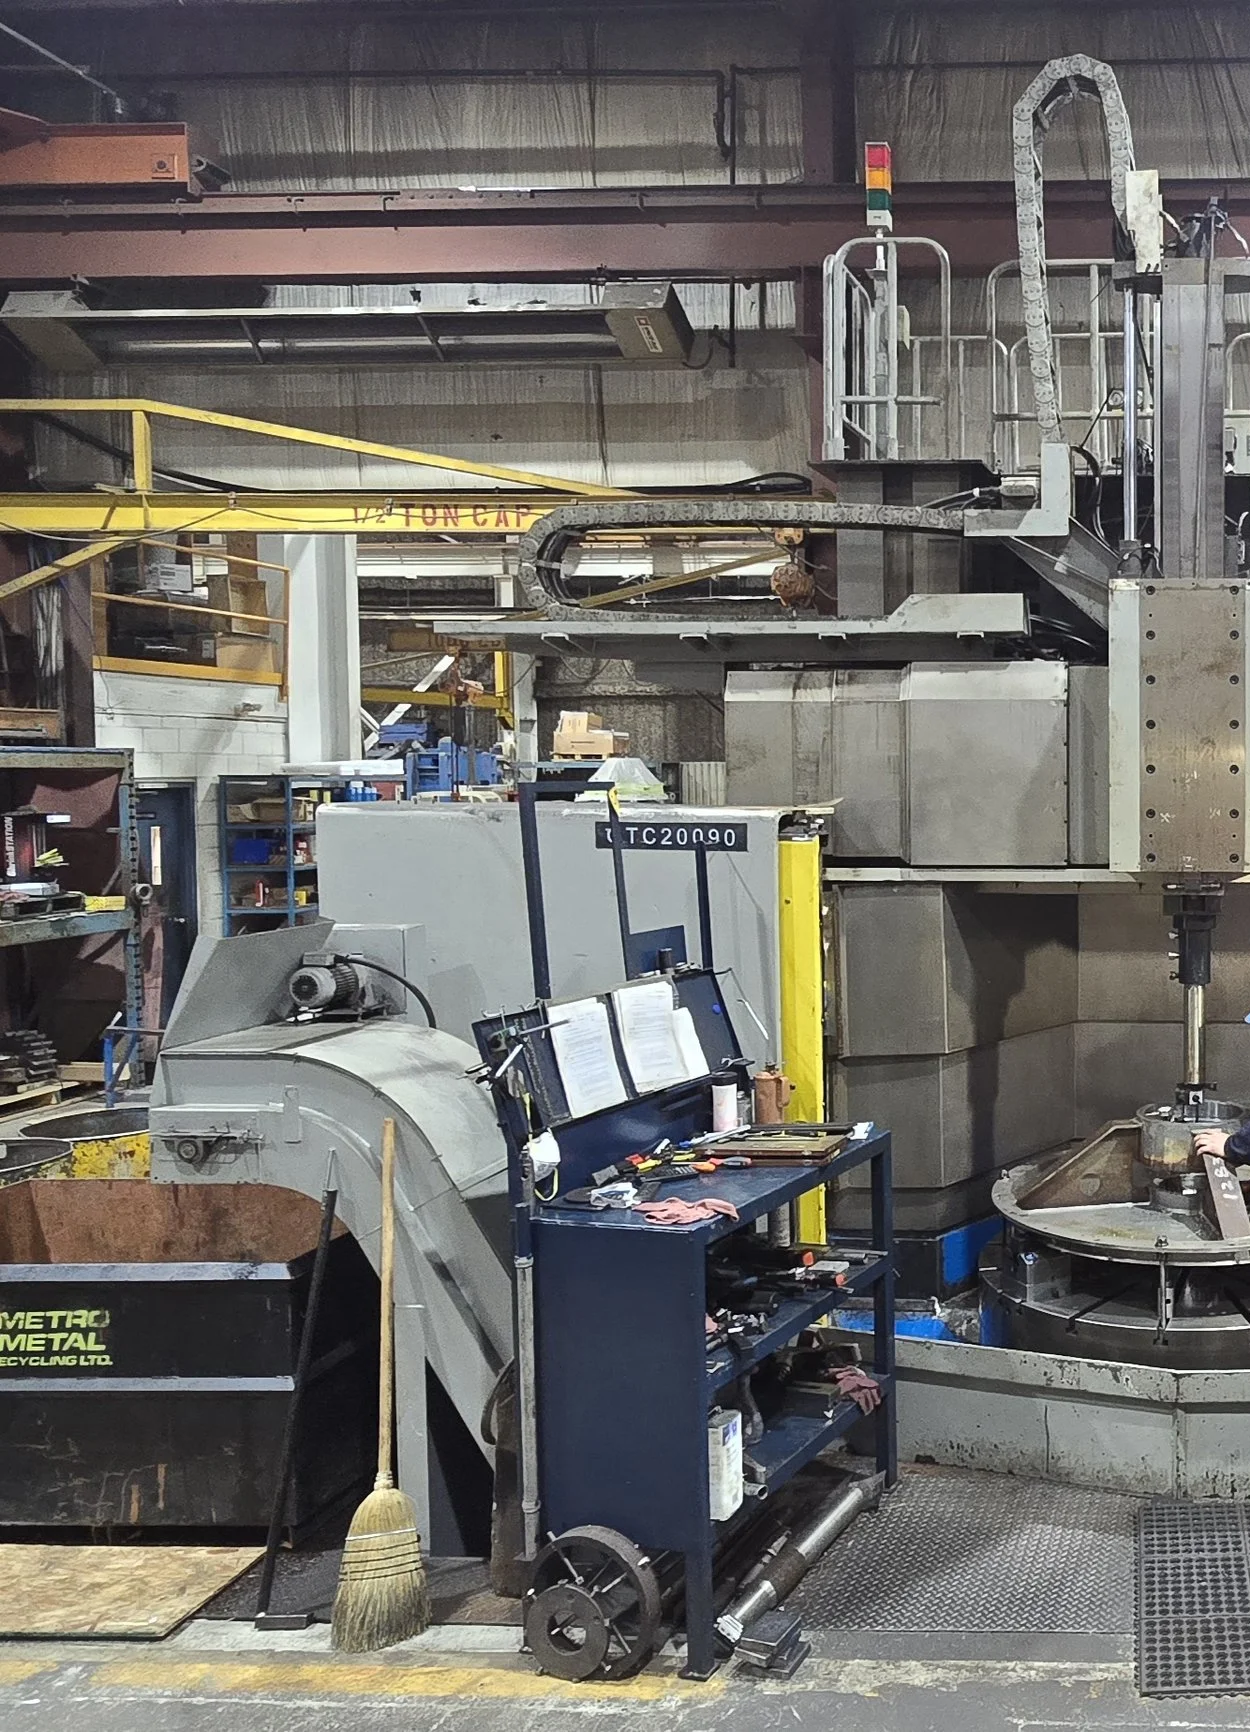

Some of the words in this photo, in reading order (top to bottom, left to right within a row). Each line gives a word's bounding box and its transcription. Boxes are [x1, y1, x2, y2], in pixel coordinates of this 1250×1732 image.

[353, 505, 386, 525] 1/2
[400, 503, 460, 527] TON
[472, 504, 531, 528] CAP
[0, 1309, 110, 1330] METRO
[0, 1332, 106, 1352] METAL
[0, 1355, 77, 1367] ECYCLING
[79, 1354, 113, 1367] LTD.
